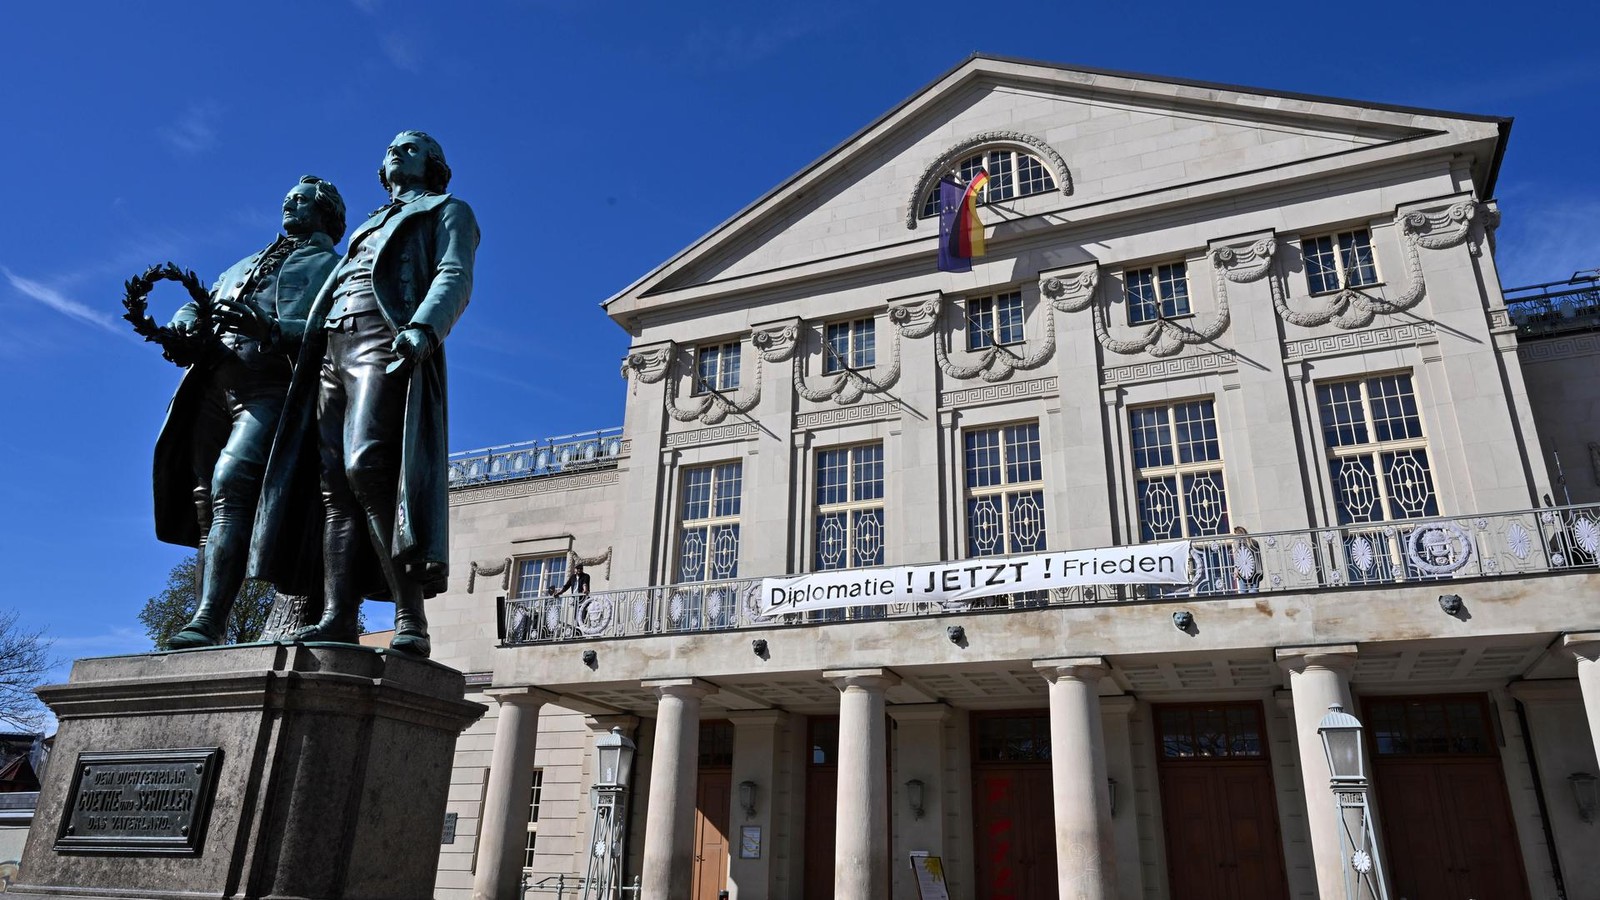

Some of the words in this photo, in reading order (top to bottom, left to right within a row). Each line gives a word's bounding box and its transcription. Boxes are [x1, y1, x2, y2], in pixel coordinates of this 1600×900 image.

[770, 578, 895, 608] Diplomatie
[923, 561, 1029, 593] JETZT
[1063, 554, 1174, 577] Frieden
[94, 771, 114, 785] DEM
[117, 770, 186, 785] DICHTERPAAR
[78, 789, 122, 812] GOETHE
[134, 789, 193, 812] SCHILLER
[87, 816, 108, 830] DAS
